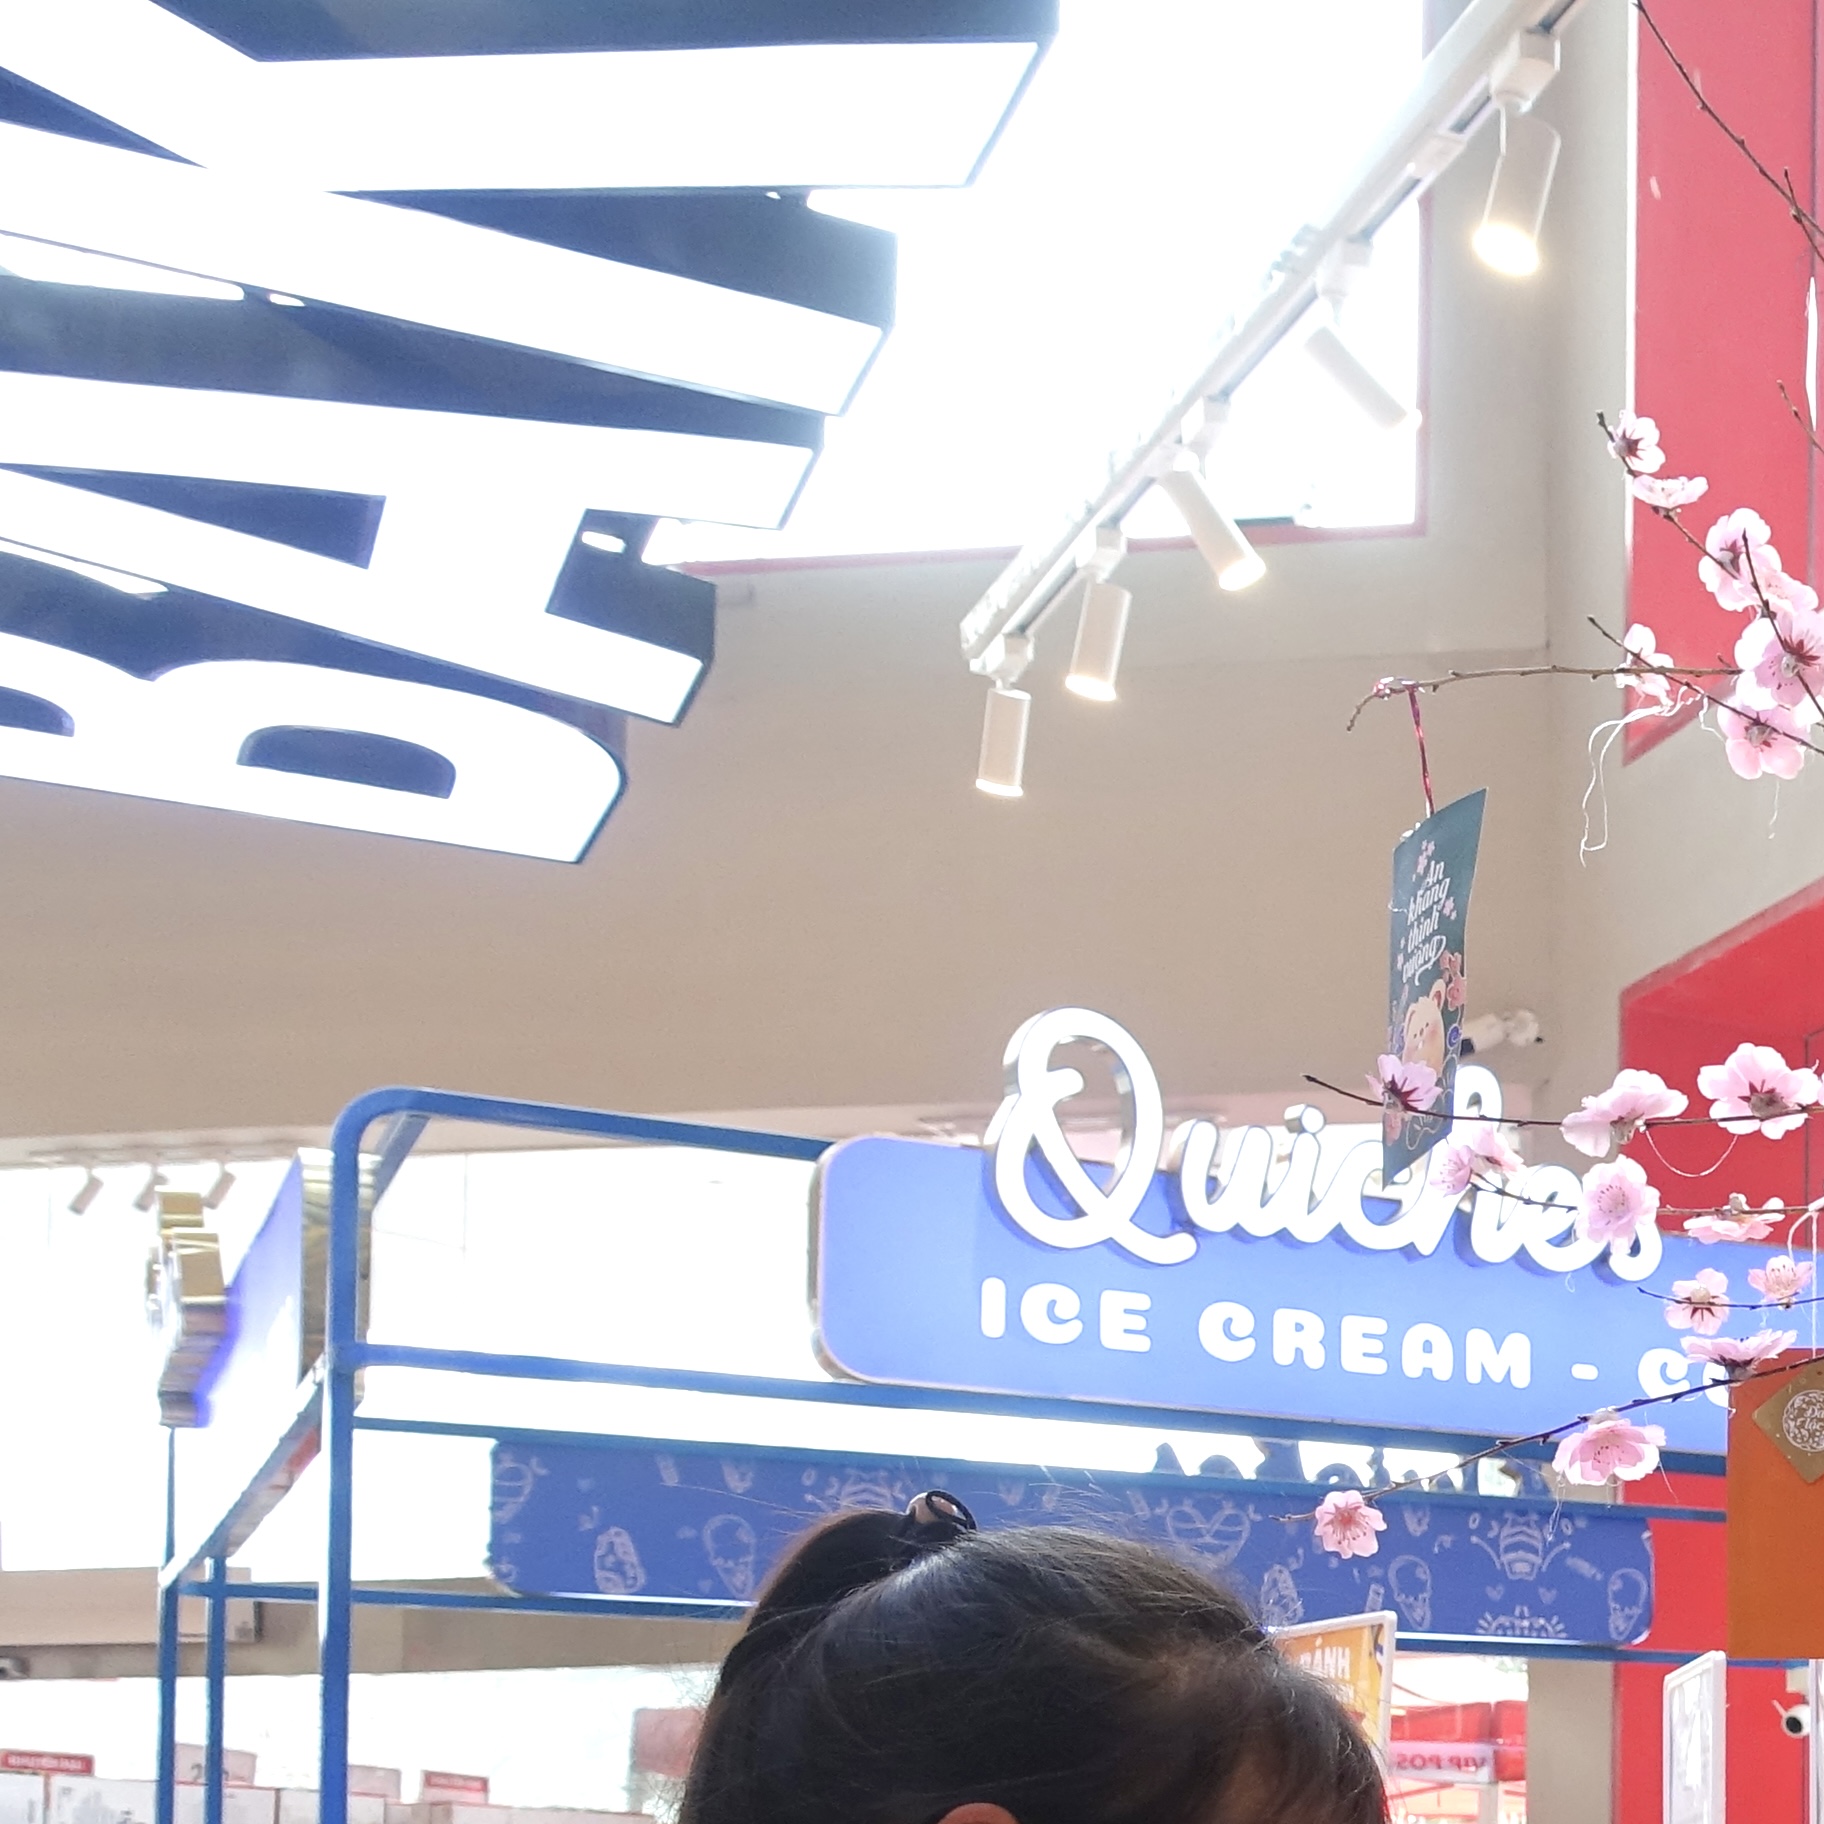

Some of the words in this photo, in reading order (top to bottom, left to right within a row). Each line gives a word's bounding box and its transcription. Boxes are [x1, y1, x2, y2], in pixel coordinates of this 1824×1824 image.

[1407, 877, 1450, 926] khang
[980, 1277, 1152, 1354] ICE
[1199, 1300, 1532, 1389] CREAM
